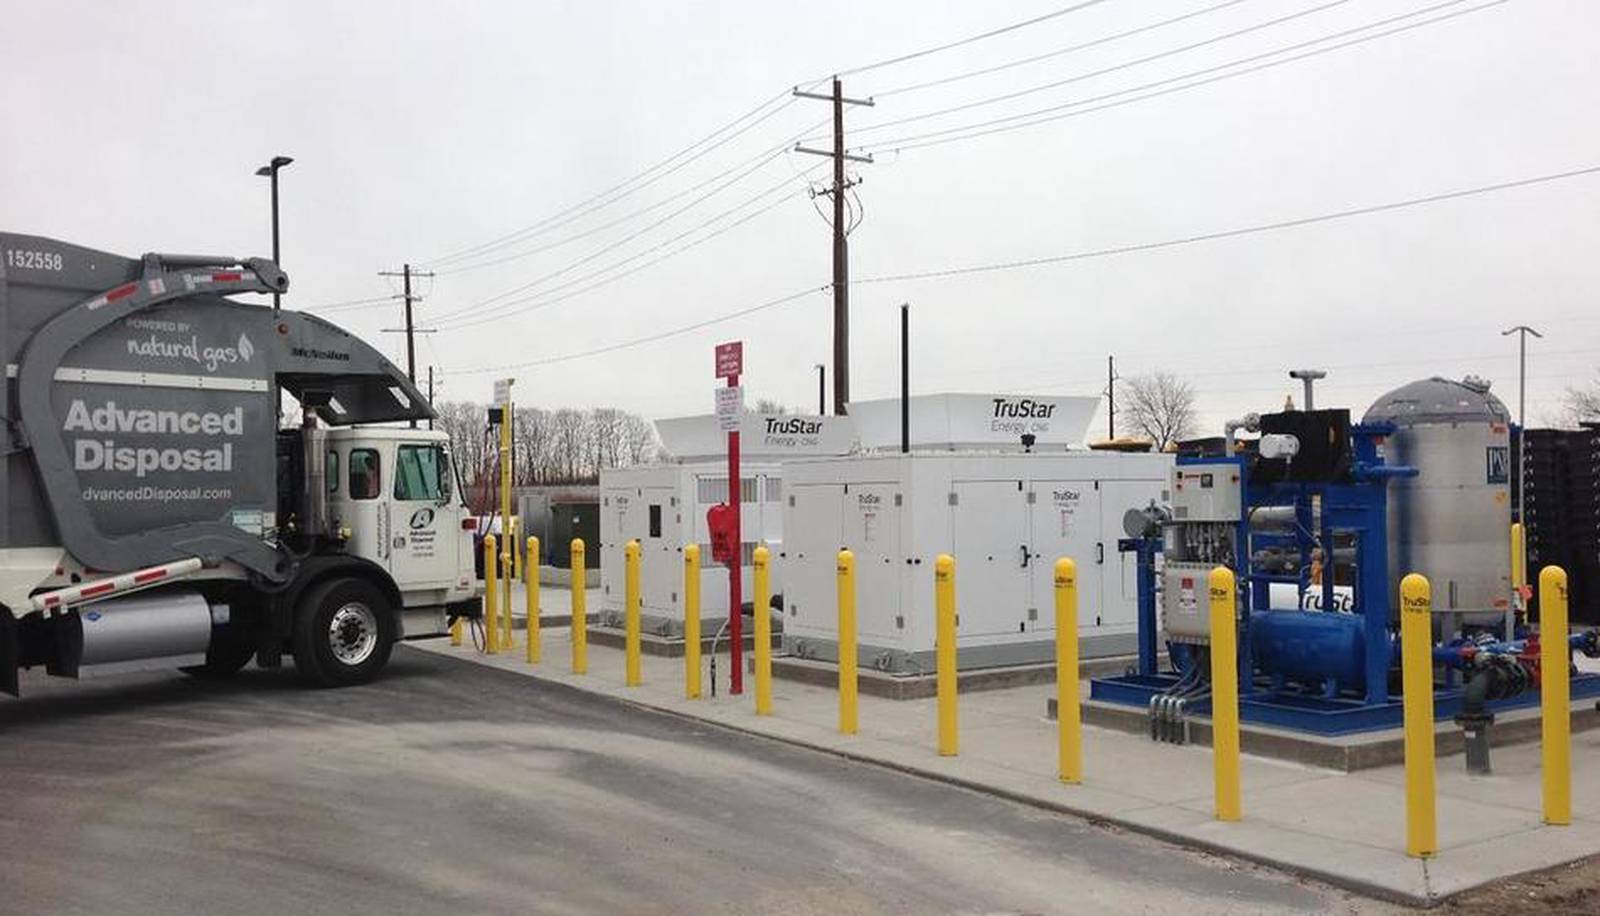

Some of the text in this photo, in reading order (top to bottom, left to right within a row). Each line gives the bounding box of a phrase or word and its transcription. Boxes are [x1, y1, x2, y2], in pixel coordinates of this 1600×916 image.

[7, 249, 64, 271] 152558
[178, 322, 191, 332] BY
[127, 335, 239, 371] natural gas
[63, 399, 244, 436] Advanced
[993, 398, 1056, 418] TruStar
[764, 417, 823, 434] TruStar
[74, 438, 233, 477] Disposal
[83, 486, 232, 503] dvancedDisposal.com
